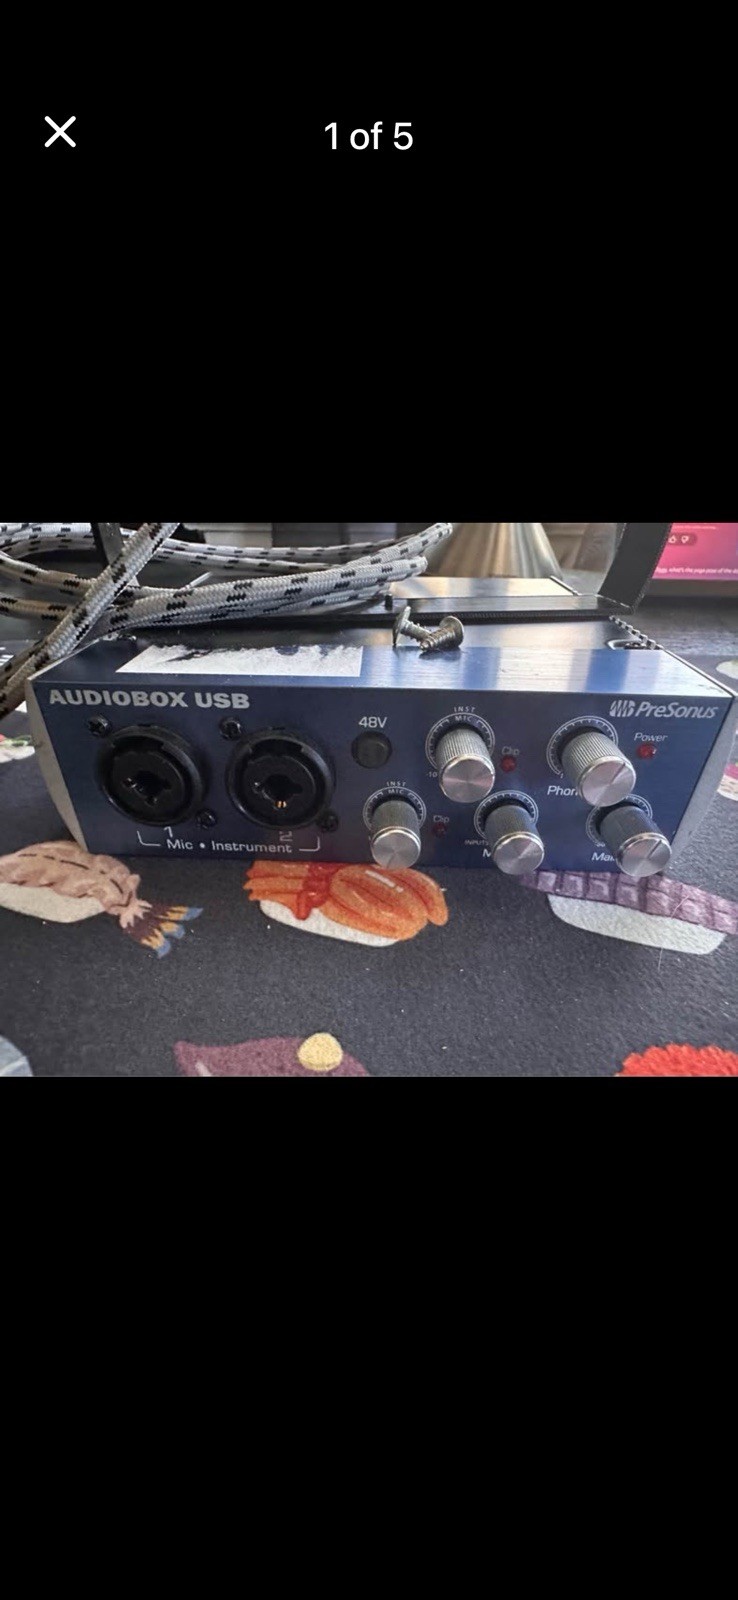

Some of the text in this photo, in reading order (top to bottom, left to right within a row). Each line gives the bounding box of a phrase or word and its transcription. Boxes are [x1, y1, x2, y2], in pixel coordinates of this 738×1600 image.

[49, 689, 250, 710] AUDIOBOX USB
[635, 701, 719, 719] PreSonus
[358, 716, 388, 729] 48V
[633, 732, 668, 743] Power
[546, 785, 579, 797] Phon
[433, 815, 450, 824] Clip
[164, 826, 173, 838] 1
[279, 831, 293, 842] 2
[166, 839, 293, 854] Mic Instrument
[591, 852, 616, 862] Mai
